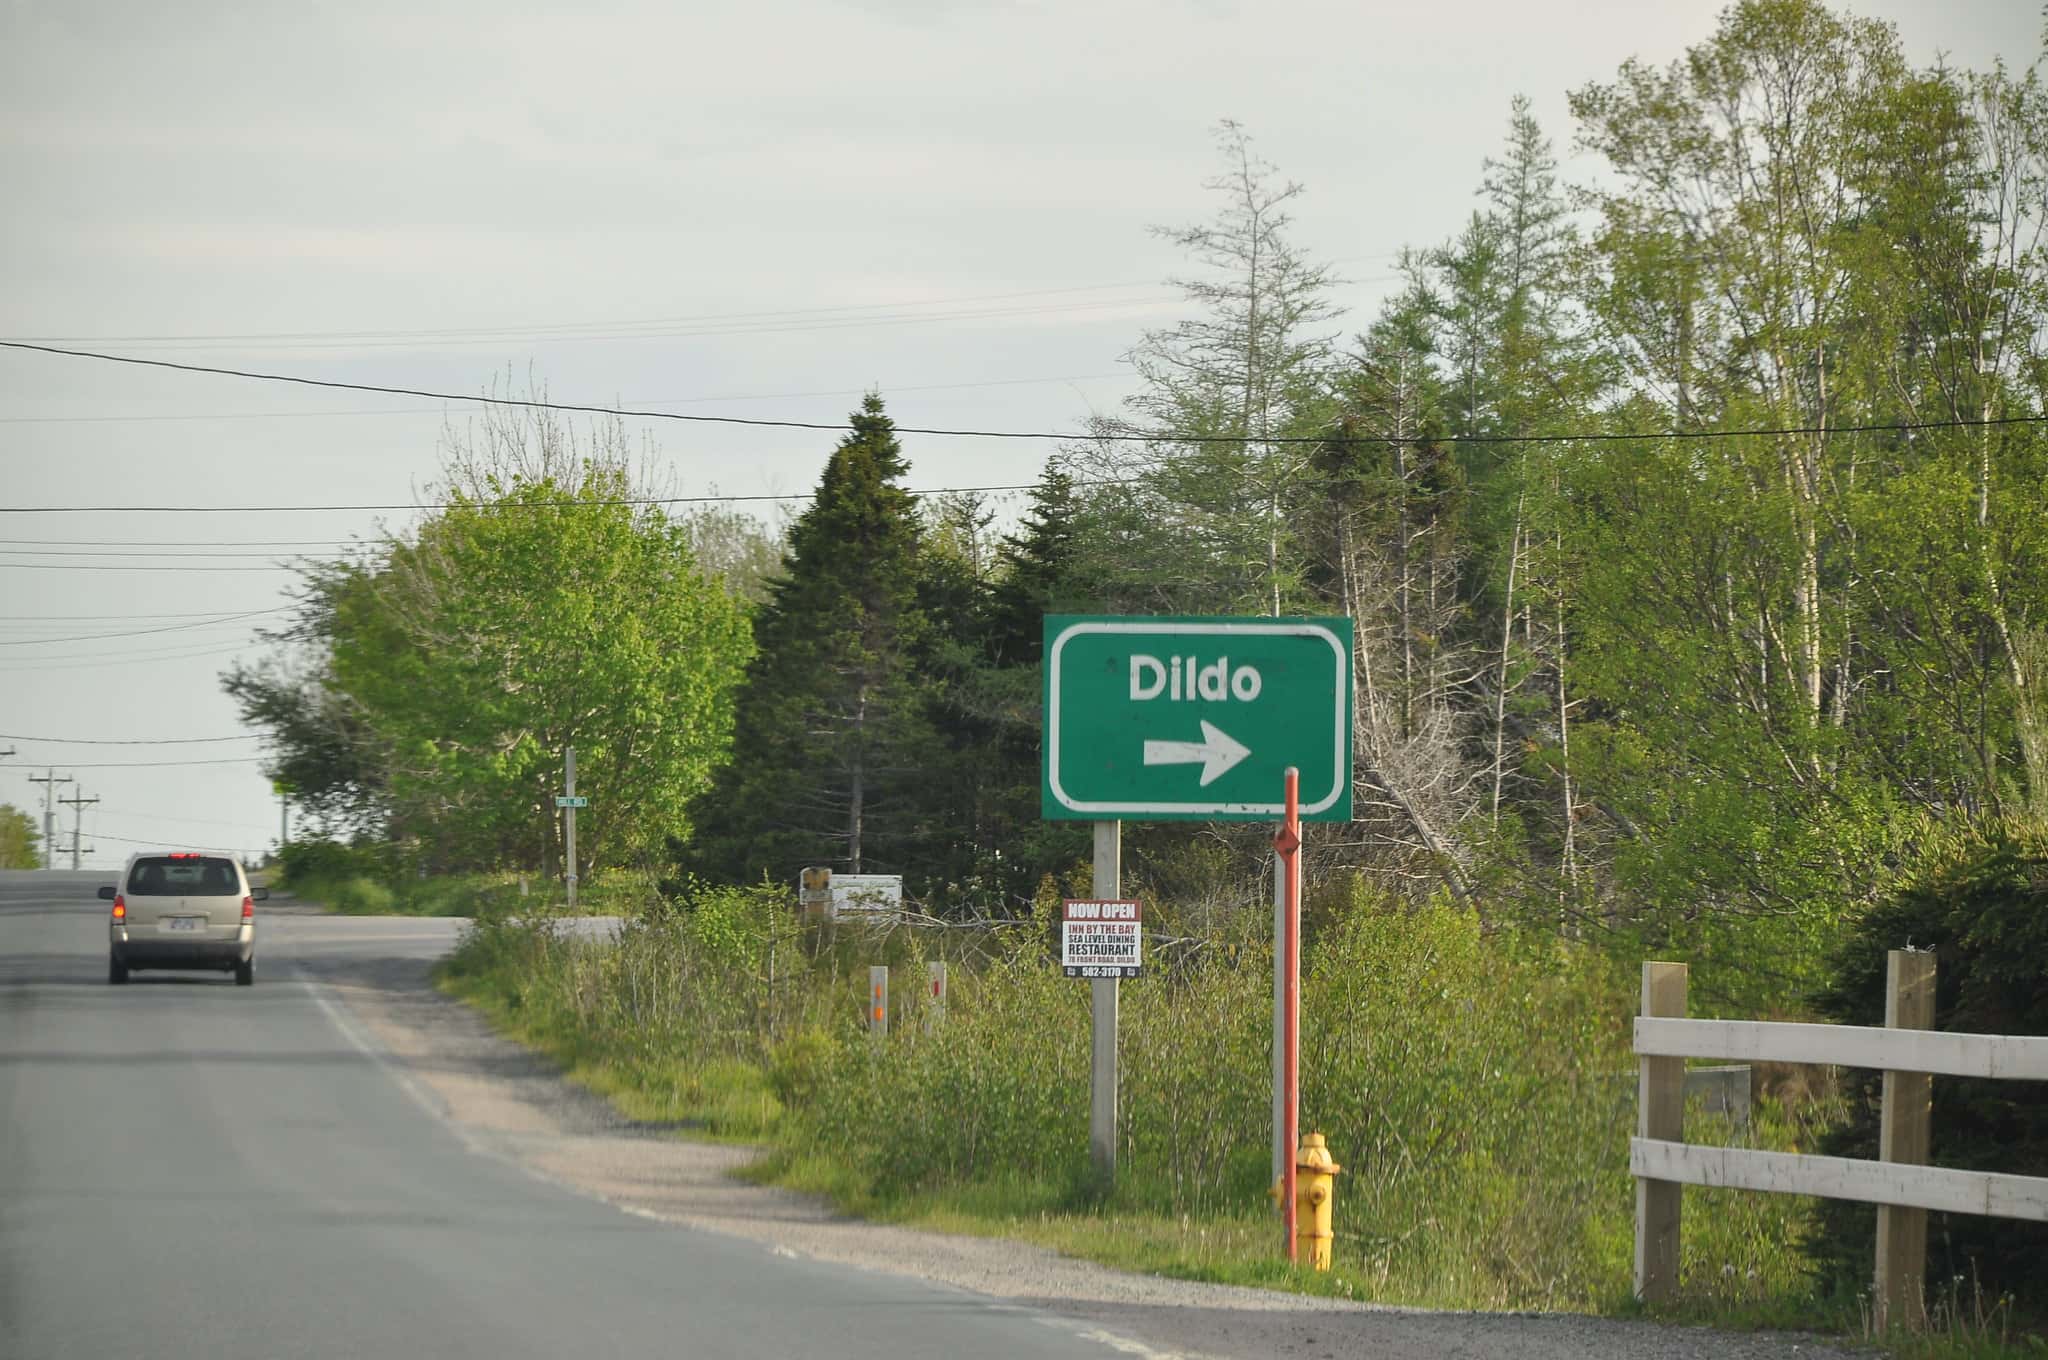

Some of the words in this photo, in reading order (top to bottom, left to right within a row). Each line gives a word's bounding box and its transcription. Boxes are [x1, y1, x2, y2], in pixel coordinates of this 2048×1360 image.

[1130, 655, 1262, 701] Dildo
[1068, 903, 1100, 918] NOW
[1102, 903, 1135, 918] OPEN
[1068, 924, 1084, 934] INN
[1086, 924, 1098, 934] BY
[1100, 924, 1117, 934] THE
[1118, 924, 1135, 934] BAY
[1068, 935, 1083, 943] SEA
[1084, 935, 1106, 943] LEVEL
[1107, 935, 1135, 943] DINING
[1068, 944, 1135, 955] RESTAURANT
